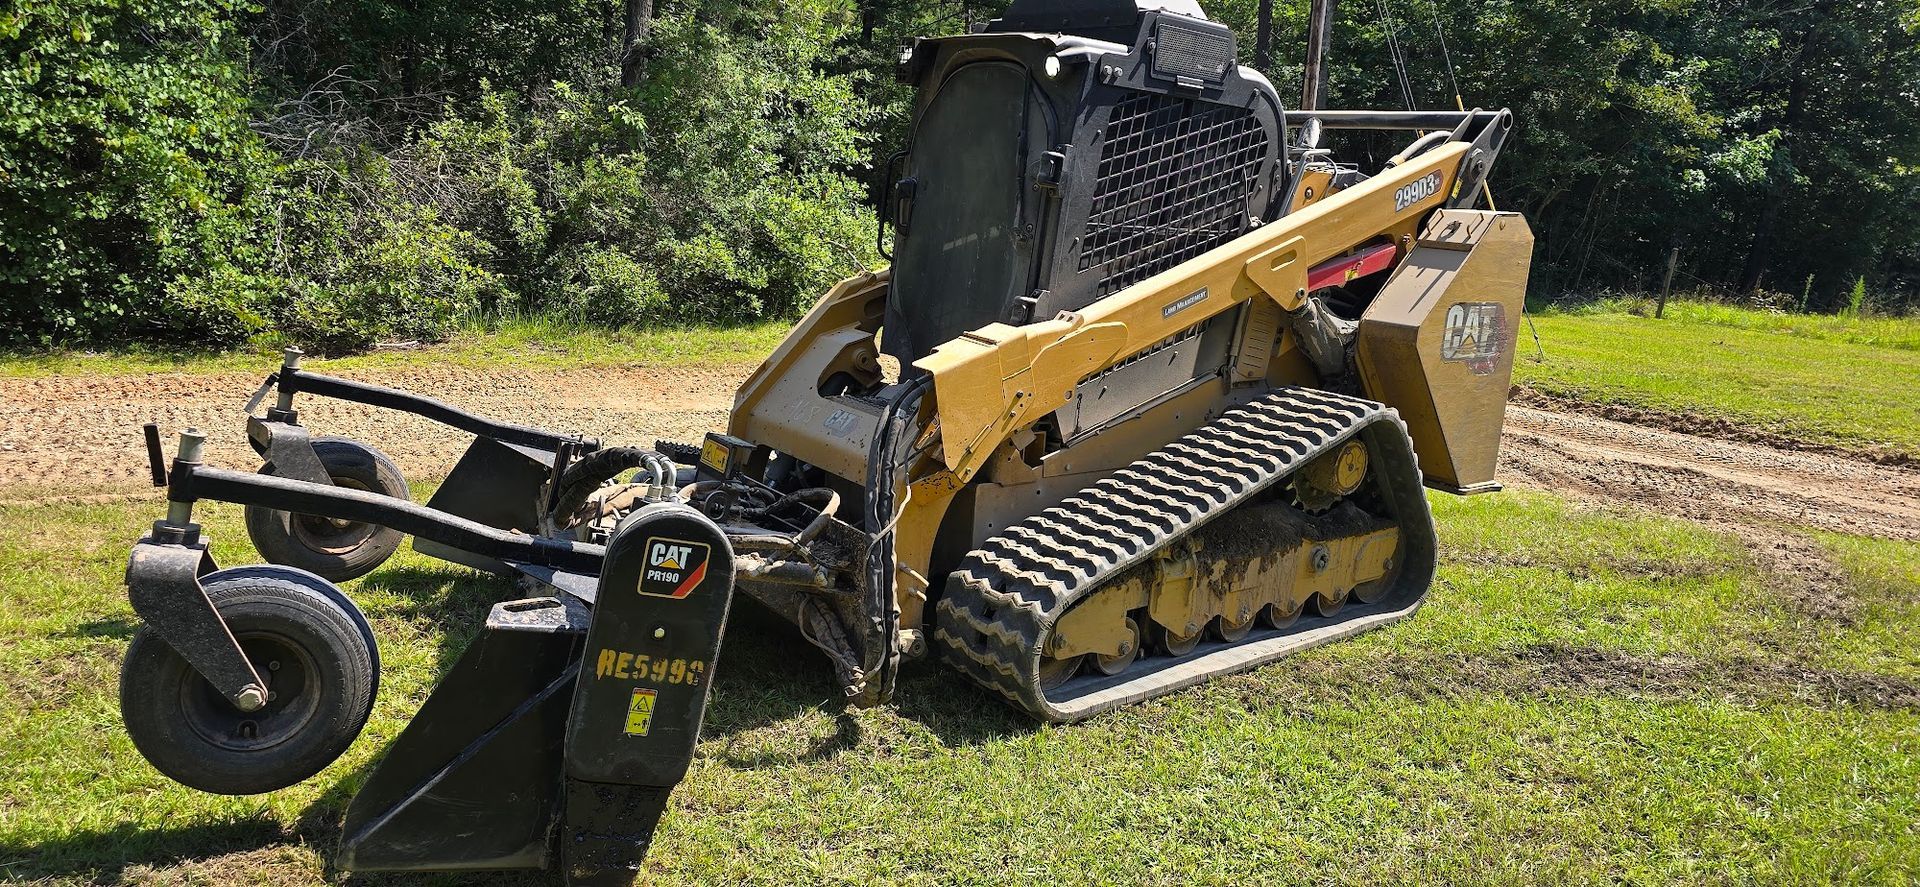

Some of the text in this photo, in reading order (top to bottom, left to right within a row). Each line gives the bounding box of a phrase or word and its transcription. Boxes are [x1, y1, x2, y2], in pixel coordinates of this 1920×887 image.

[1395, 174, 1435, 212] 299D3
[1443, 305, 1497, 359] CAT
[824, 410, 857, 430] CAT
[650, 542, 692, 570] CAT
[646, 569, 680, 584] PR190
